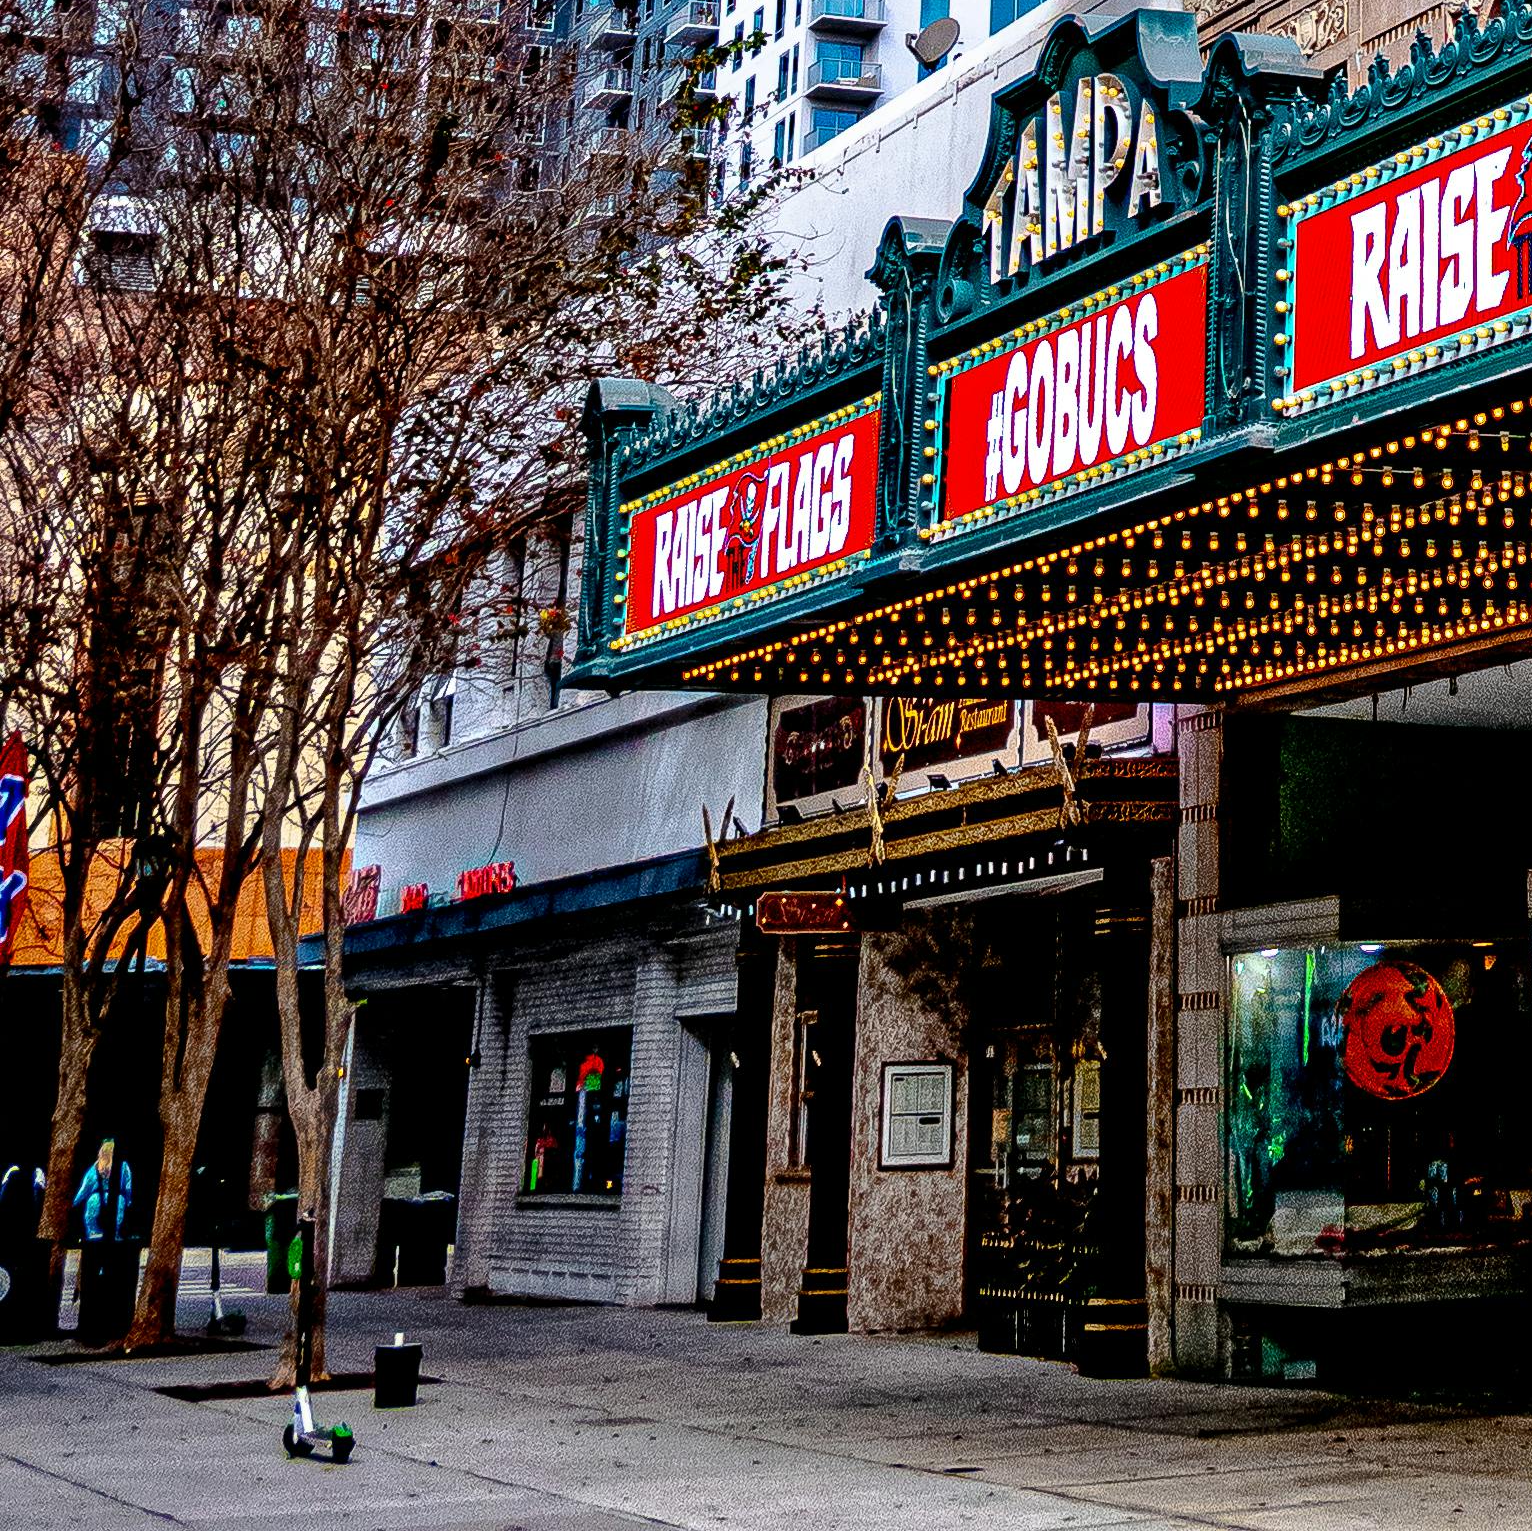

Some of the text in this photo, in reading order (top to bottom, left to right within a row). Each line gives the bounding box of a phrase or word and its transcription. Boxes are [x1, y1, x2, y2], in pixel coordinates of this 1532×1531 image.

[981, 72, 1162, 286] TAMPA
[1349, 145, 1514, 360] RAISE
[984, 292, 1159, 503] #GOBUCS
[652, 485, 730, 619] RAISE
[760, 433, 855, 579] FLAGS
[959, 700, 1008, 732] Restaurant
